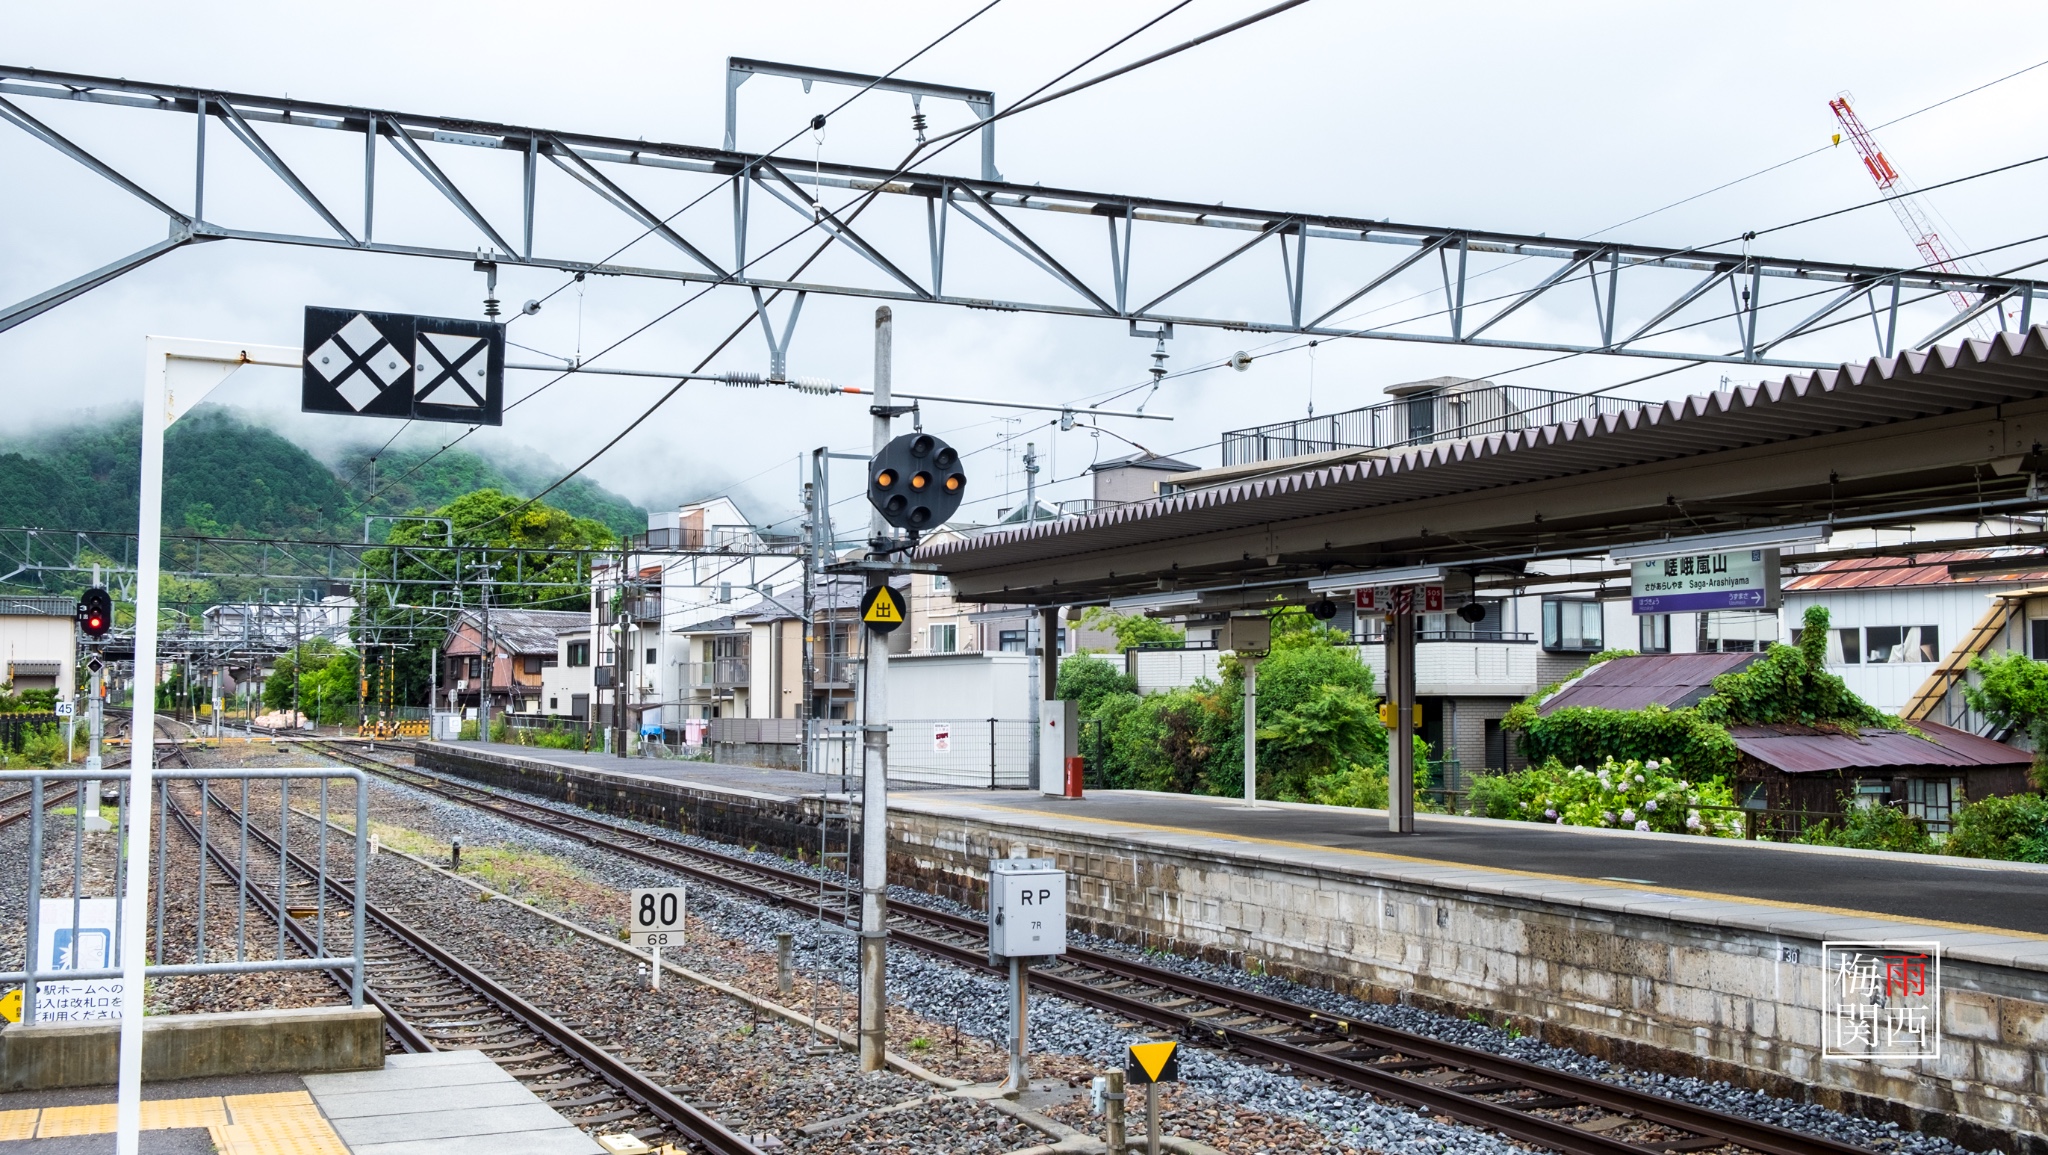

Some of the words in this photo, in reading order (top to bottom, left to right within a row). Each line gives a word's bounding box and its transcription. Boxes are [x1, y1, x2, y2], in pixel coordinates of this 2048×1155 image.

[1664, 553, 1727, 577] 嵯峨嵐山
[1645, 581, 1683, 591] さがあらしやま
[1689, 577, 1750, 590] Saga-Arashiyama
[876, 602, 890, 617] 出
[58, 704, 73, 714] 45
[639, 893, 677, 926] 80
[1031, 921, 1042, 930] 7R
[647, 934, 668, 945] 68
[1785, 950, 1798, 964] 30
[43, 984, 124, 996] 駅ホームへの
